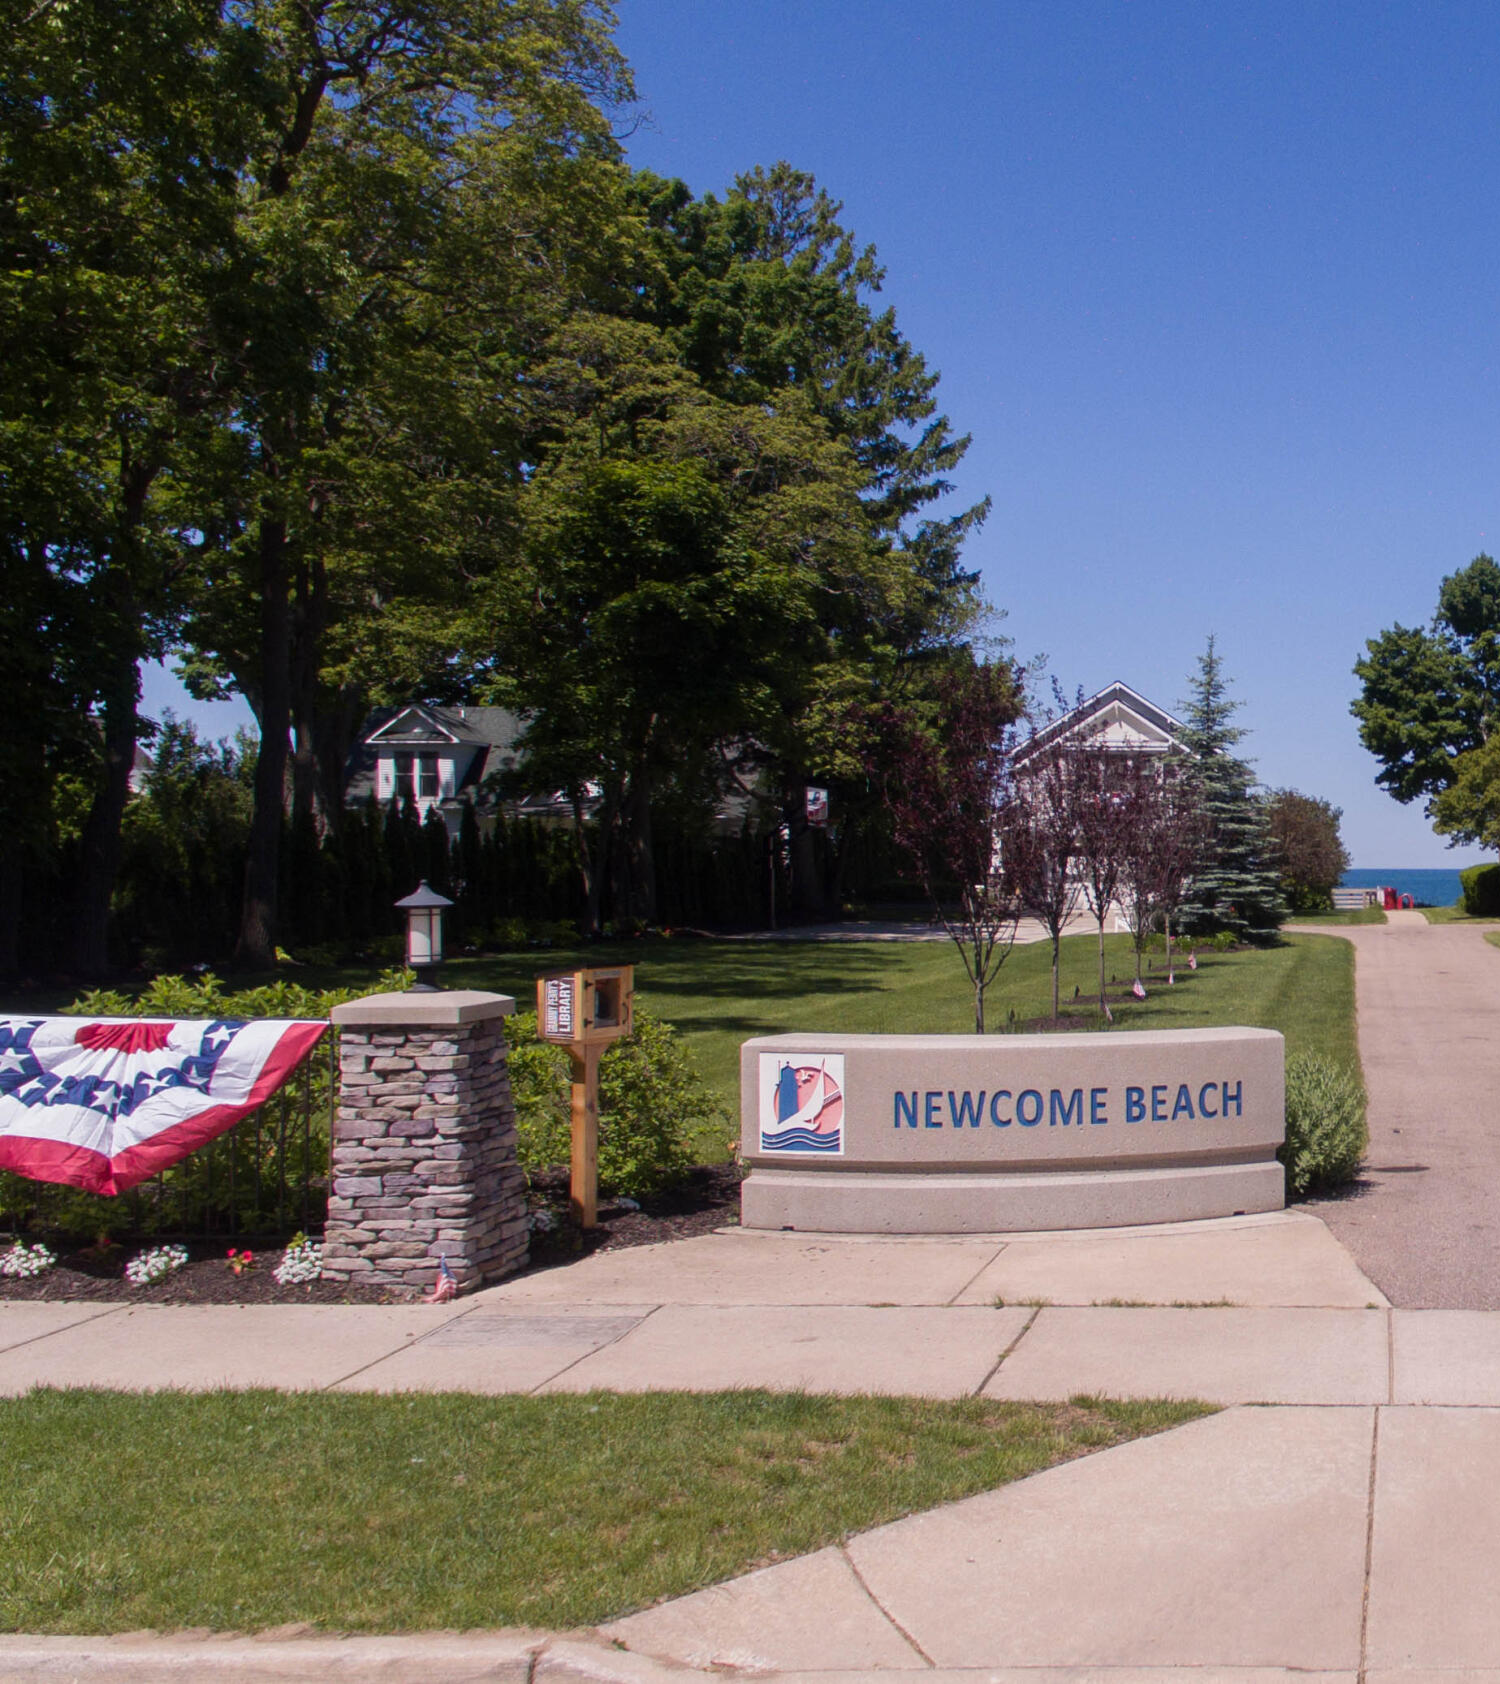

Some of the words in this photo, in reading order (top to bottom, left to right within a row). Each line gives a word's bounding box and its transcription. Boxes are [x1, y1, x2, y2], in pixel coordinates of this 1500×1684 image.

[559, 981, 571, 1032] LIBRARY
[893, 1087, 1108, 1129] NEWCOME
[1125, 1080, 1243, 1124] BEACH
